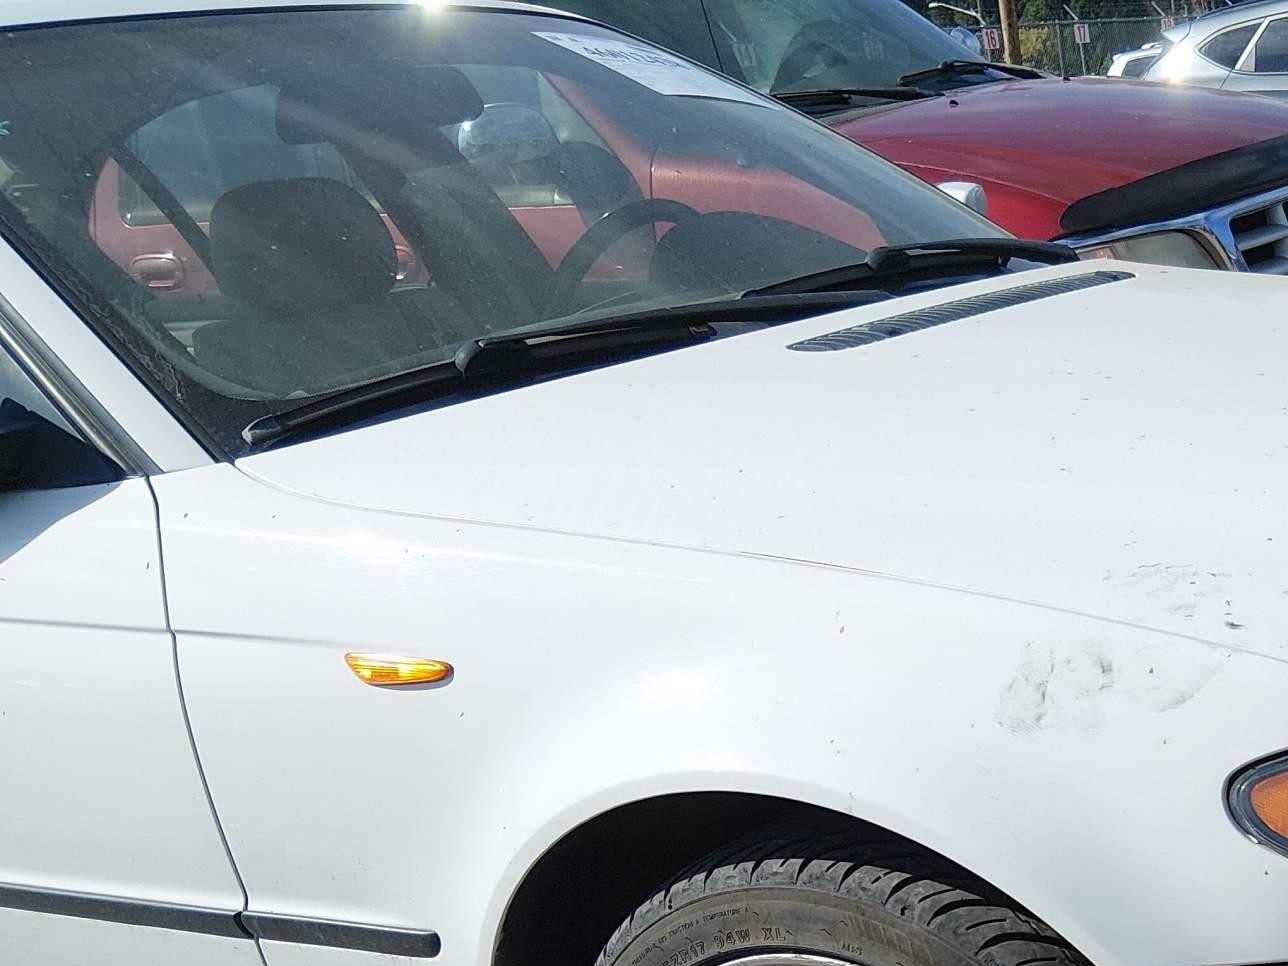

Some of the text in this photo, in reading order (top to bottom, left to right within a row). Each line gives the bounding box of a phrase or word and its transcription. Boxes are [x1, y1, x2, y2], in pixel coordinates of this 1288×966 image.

[985, 29, 997, 49] 16
[1077, 24, 1087, 42] 17
[714, 929, 750, 949] 94W
[761, 927, 786, 940] XL
